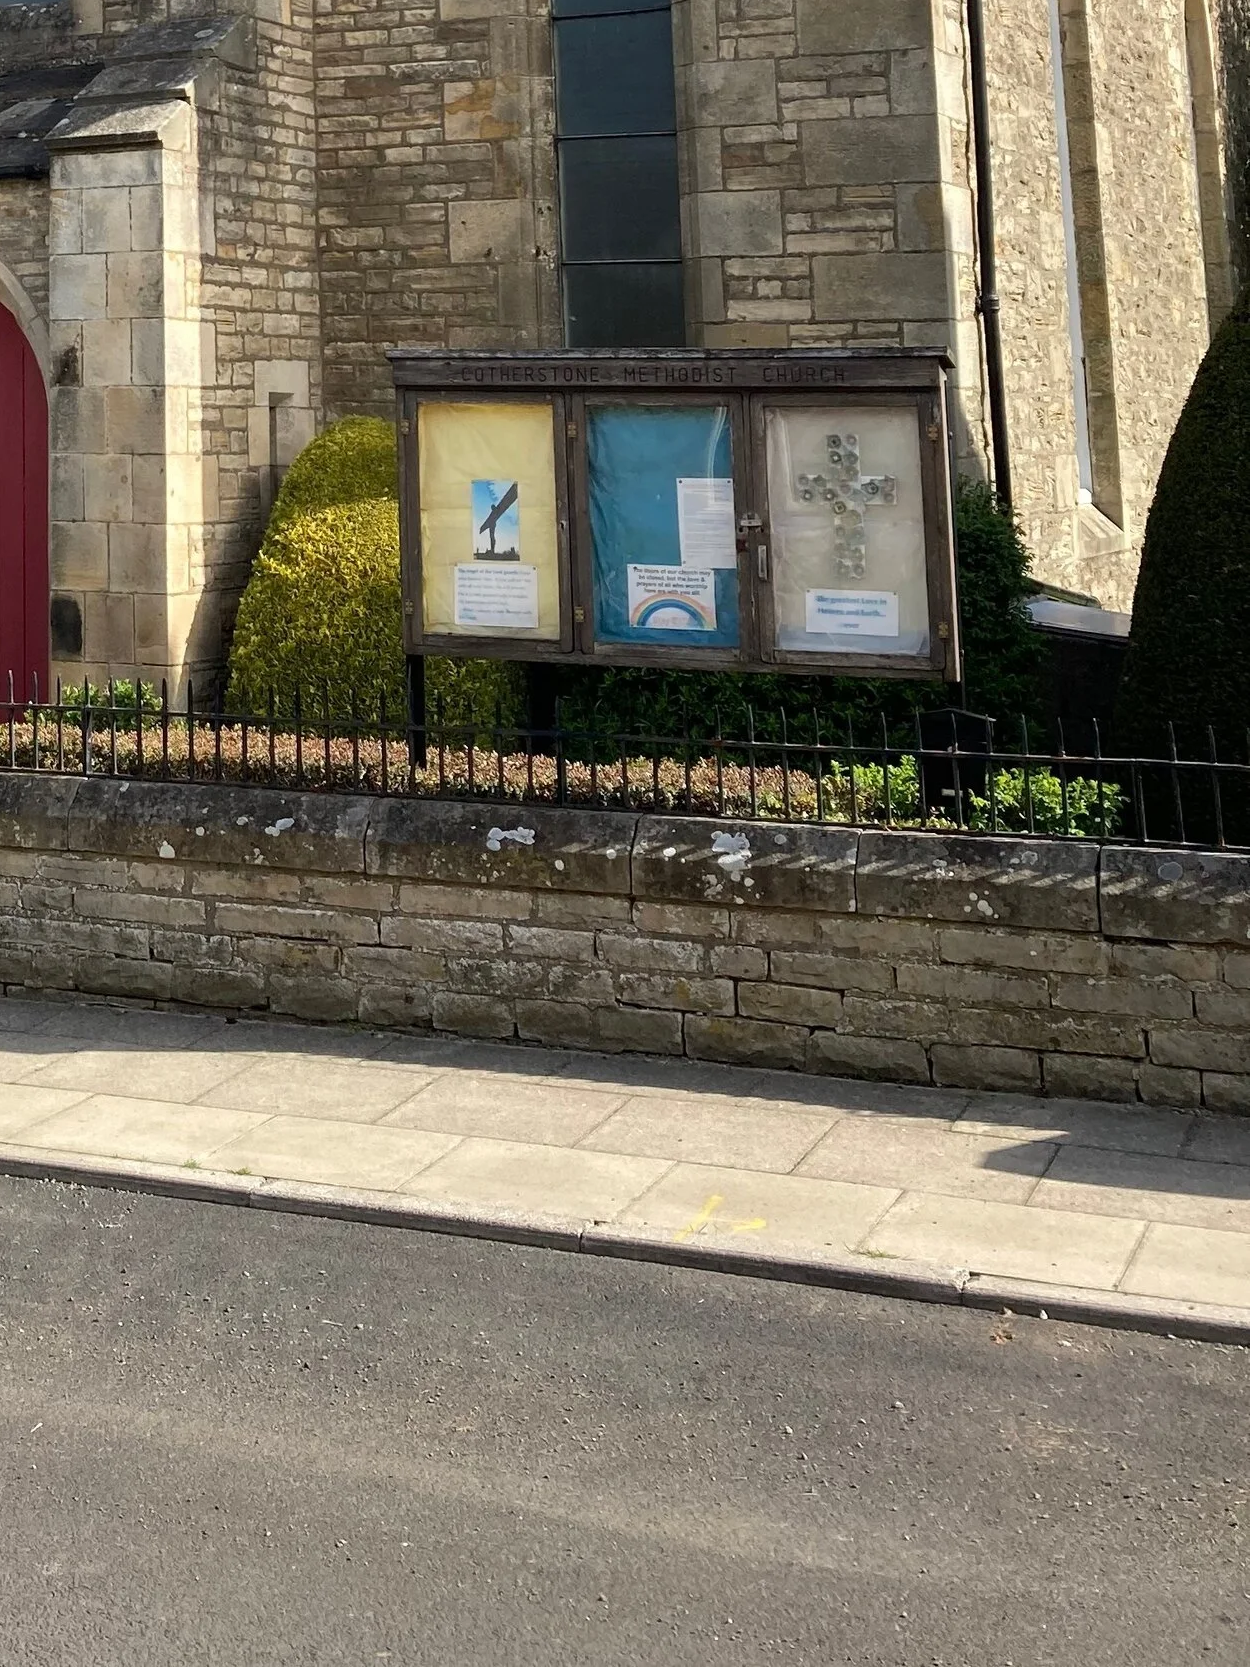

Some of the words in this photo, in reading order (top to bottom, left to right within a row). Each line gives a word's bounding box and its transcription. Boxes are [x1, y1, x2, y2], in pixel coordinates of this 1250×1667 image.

[462, 366, 600, 383] COTHERSTONE
[623, 367, 737, 384] METHODIST
[762, 366, 845, 384] CHURCH
